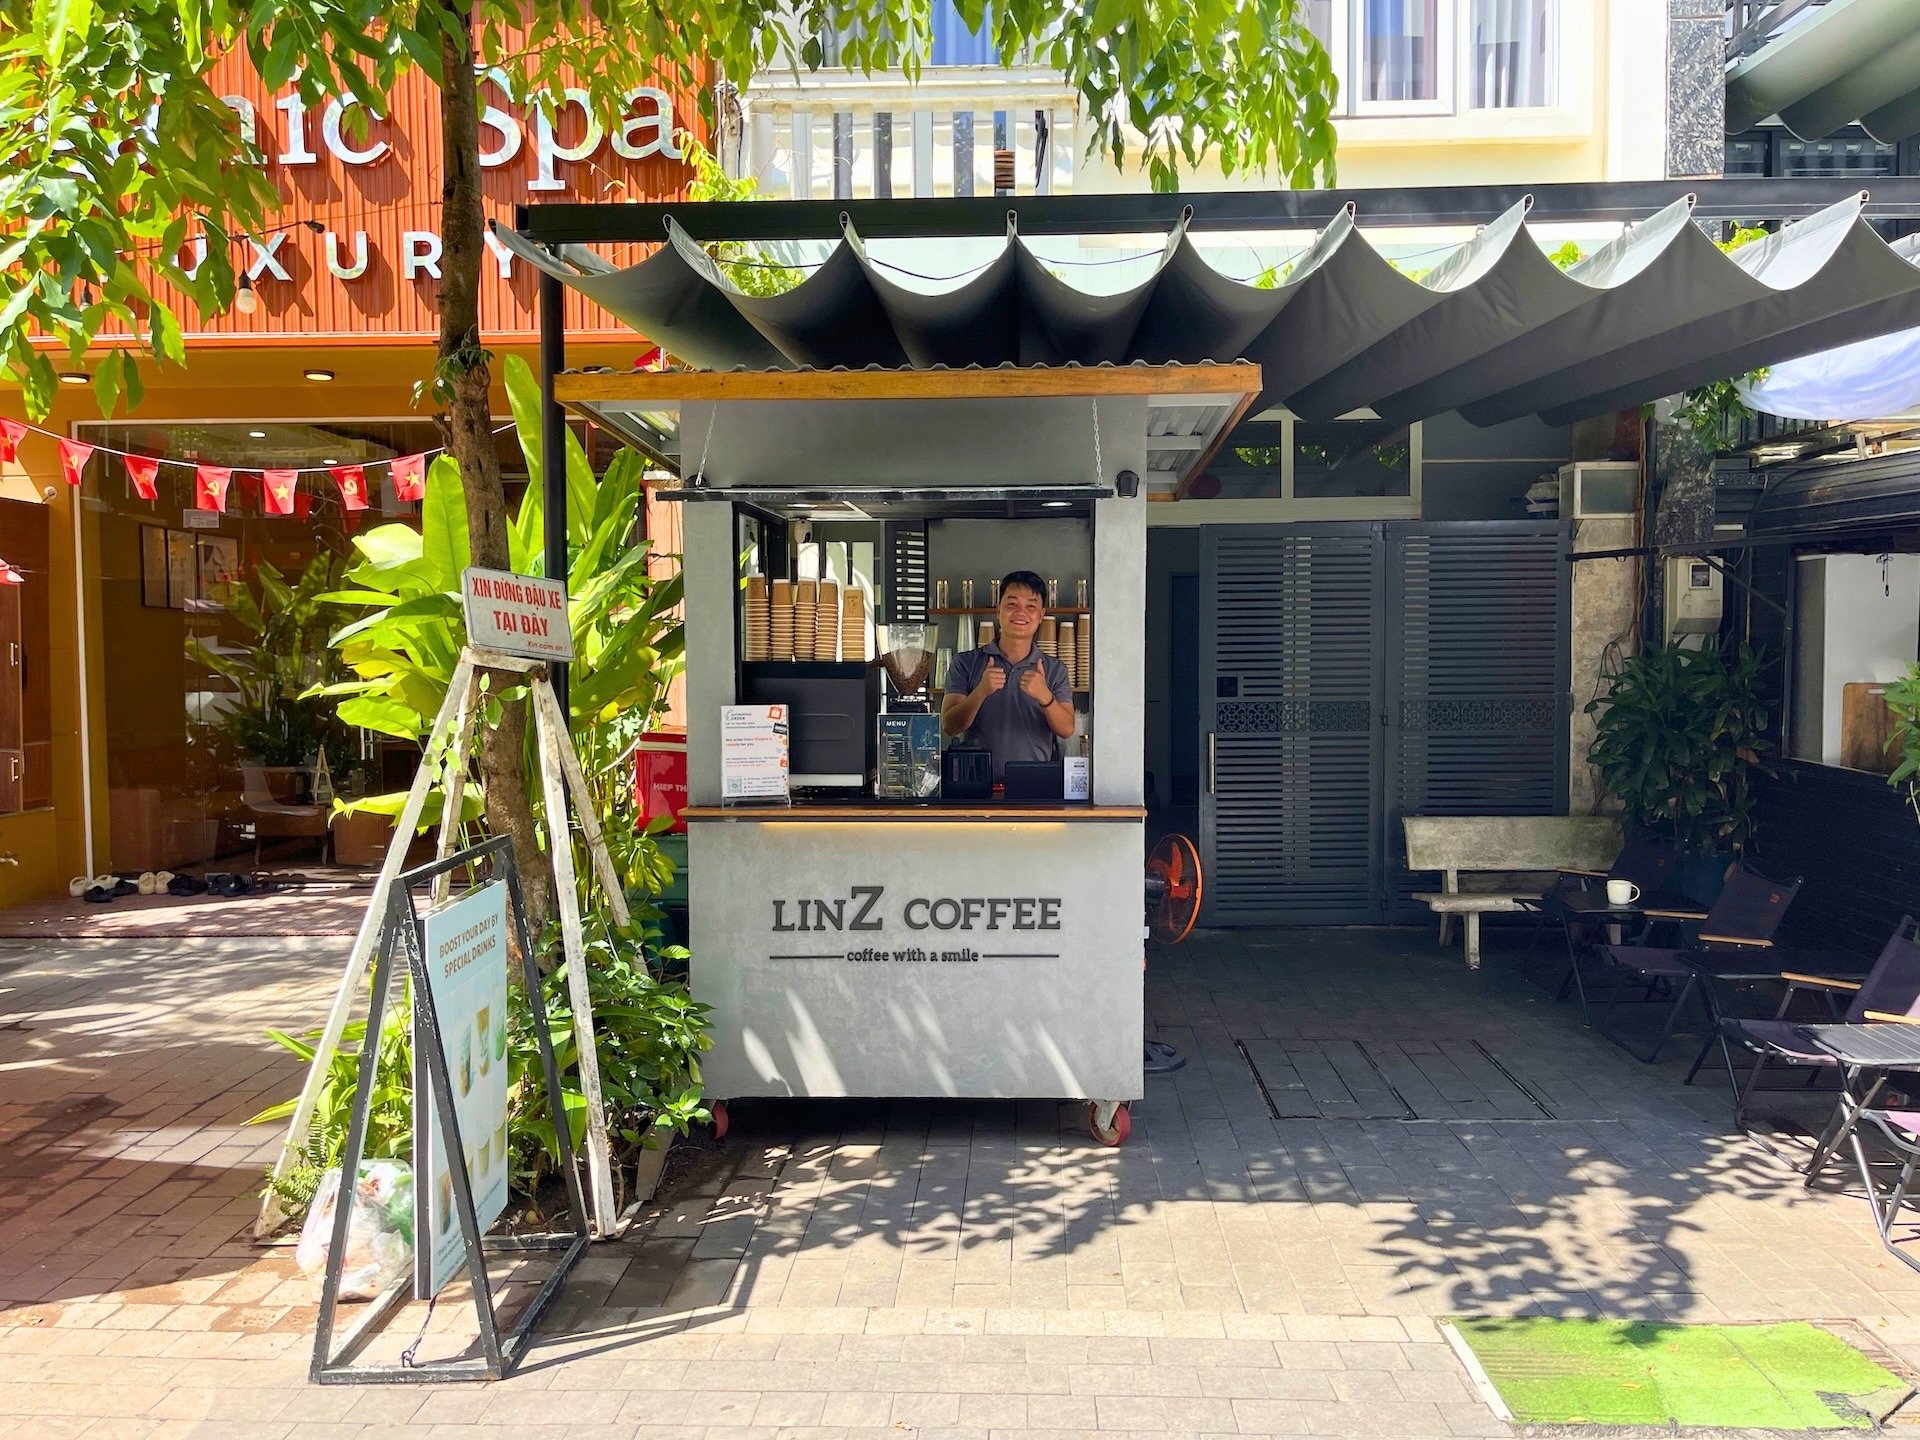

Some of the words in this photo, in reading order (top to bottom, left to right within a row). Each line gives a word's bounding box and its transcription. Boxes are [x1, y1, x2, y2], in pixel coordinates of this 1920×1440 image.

[476, 62, 682, 190] Spa
[96, 229, 516, 283] UXURY
[472, 577, 492, 598] XIN
[493, 577, 523, 603] ĐỪNG
[525, 583, 546, 610] ĐẬU
[548, 590, 562, 609] XE
[493, 610, 517, 635] TẠI
[521, 612, 548, 636] ĐÂY
[527, 640, 538, 648] Xin
[903, 898, 1061, 930] COFFEE
[439, 934, 461, 959] BOOST
[461, 924, 479, 944] YOUR
[479, 917, 491, 934] DAY
[491, 912, 499, 927] BY
[444, 950, 472, 979] SPECIAL
[472, 934, 496, 960] DRINKS
[847, 948, 889, 962] coffee
[892, 948, 927, 962] with
[930, 951, 938, 962] a
[941, 948, 979, 962] smile
